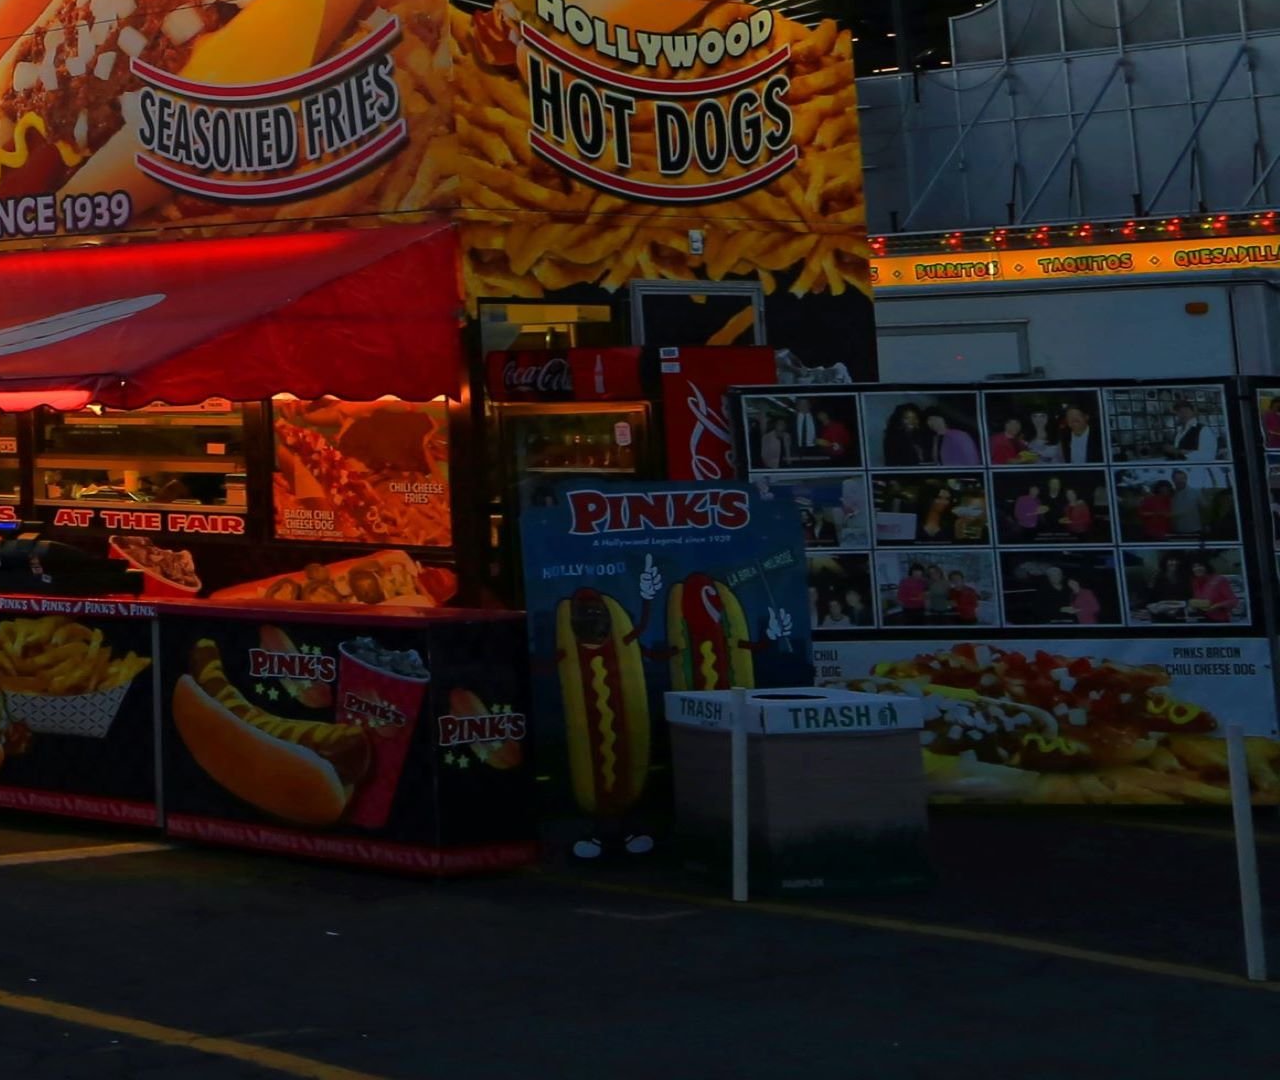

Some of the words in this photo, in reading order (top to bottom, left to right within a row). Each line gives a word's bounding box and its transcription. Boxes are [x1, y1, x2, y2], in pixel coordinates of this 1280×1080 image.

[138, 86, 297, 169] SEASONED
[302, 54, 400, 159] FRIES
[527, 53, 636, 168] HOT
[653, 74, 793, 175] DOGS
[62, 191, 131, 230] 1939
[914, 260, 1001, 280] BURRITOS
[1038, 253, 1134, 273] TAQUITOS
[404, 493, 429, 504] FRIES
[565, 488, 750, 535] PINK'S
[53, 509, 91, 528] AT
[98, 511, 162, 531] THE
[167, 514, 246, 534] FAIR
[248, 648, 336, 682] PINK'S
[814, 650, 838, 661] CHILI
[1173, 647, 1203, 658] PINKS
[1206, 647, 1242, 658] BACON
[1194, 663, 1231, 675] CHEESE
[1234, 663, 1256, 675] DOG
[344, 692, 406, 728] PINK'S
[680, 697, 723, 720] TRASH
[789, 705, 872, 729] TRASH
[438, 713, 527, 746] PINK'S
